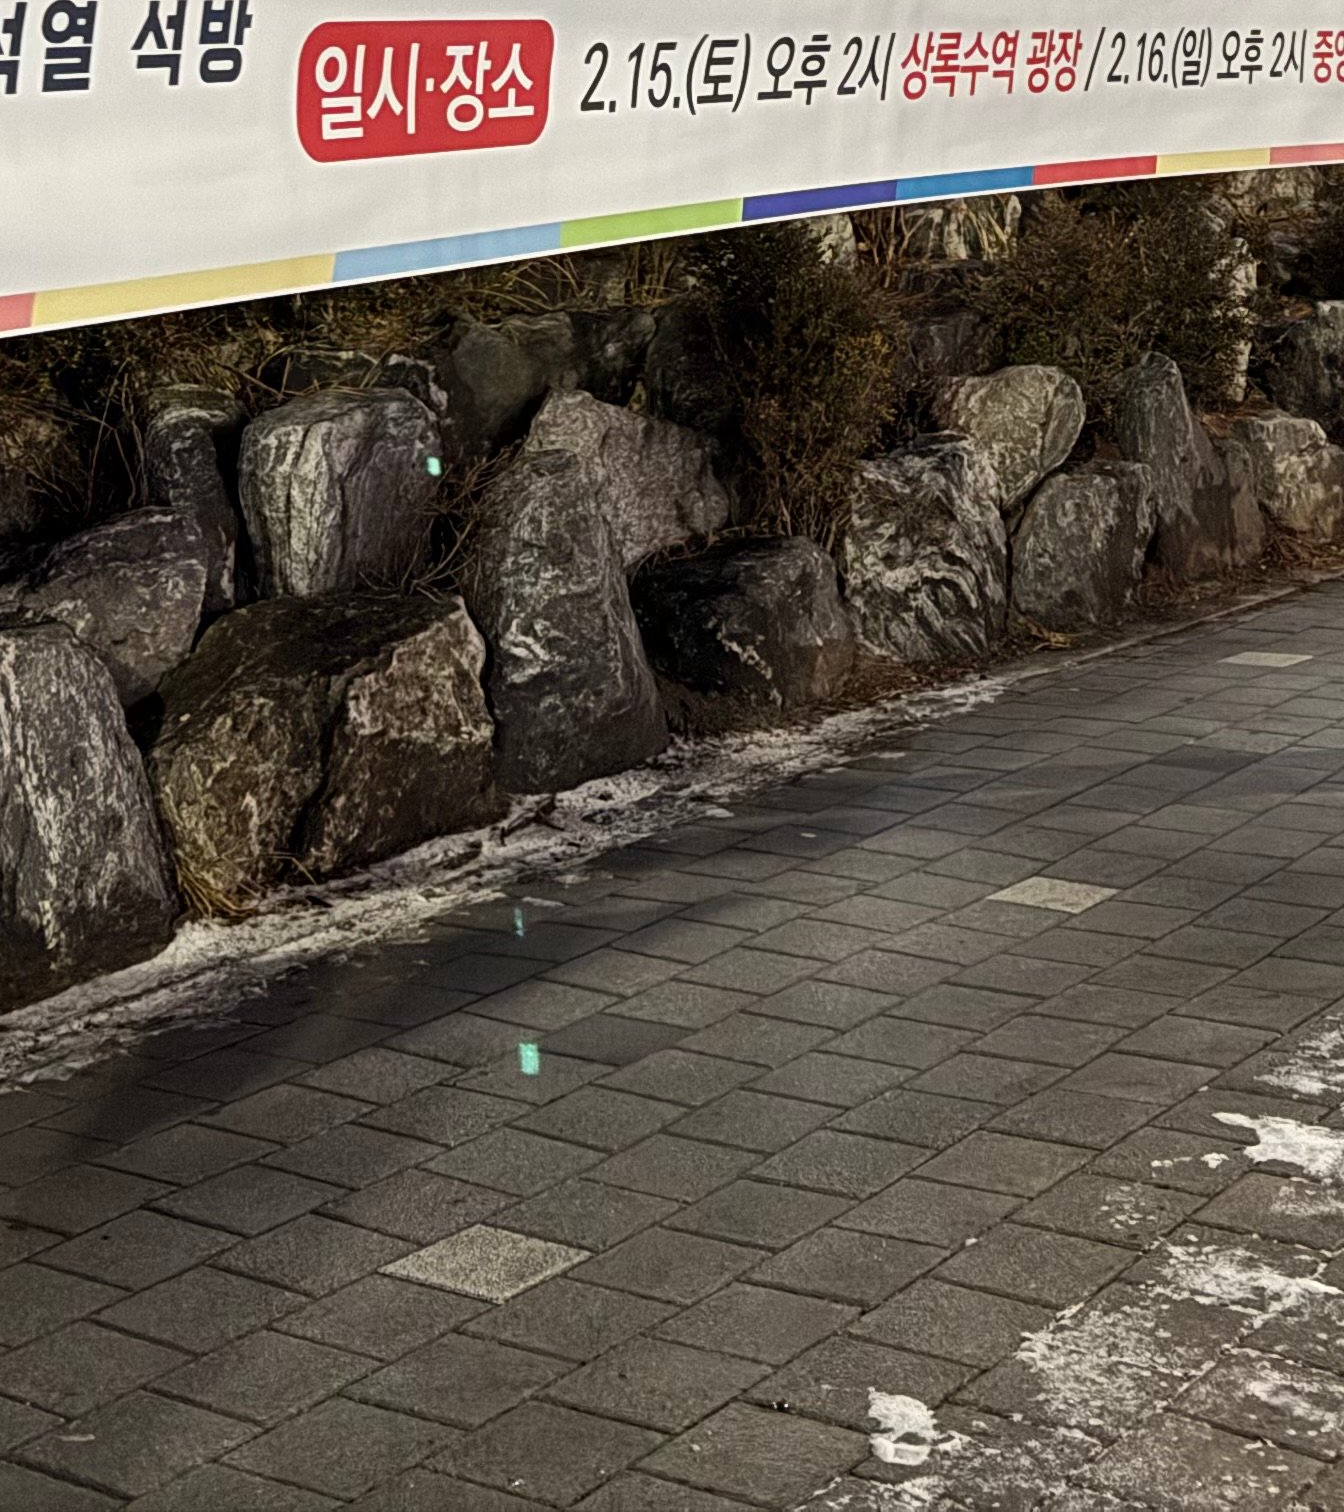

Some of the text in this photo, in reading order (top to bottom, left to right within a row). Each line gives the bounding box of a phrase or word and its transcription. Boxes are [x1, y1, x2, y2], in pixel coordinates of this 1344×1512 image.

[313, 40, 536, 142] 일시·장소
[756, 33, 832, 106] 오후
[836, 32, 896, 101] 2시
[900, 28, 1021, 101] 상록수역
[1025, 28, 1083, 94] 광장
[1216, 28, 1265, 85] 오후
[1270, 28, 1308, 84] 2시
